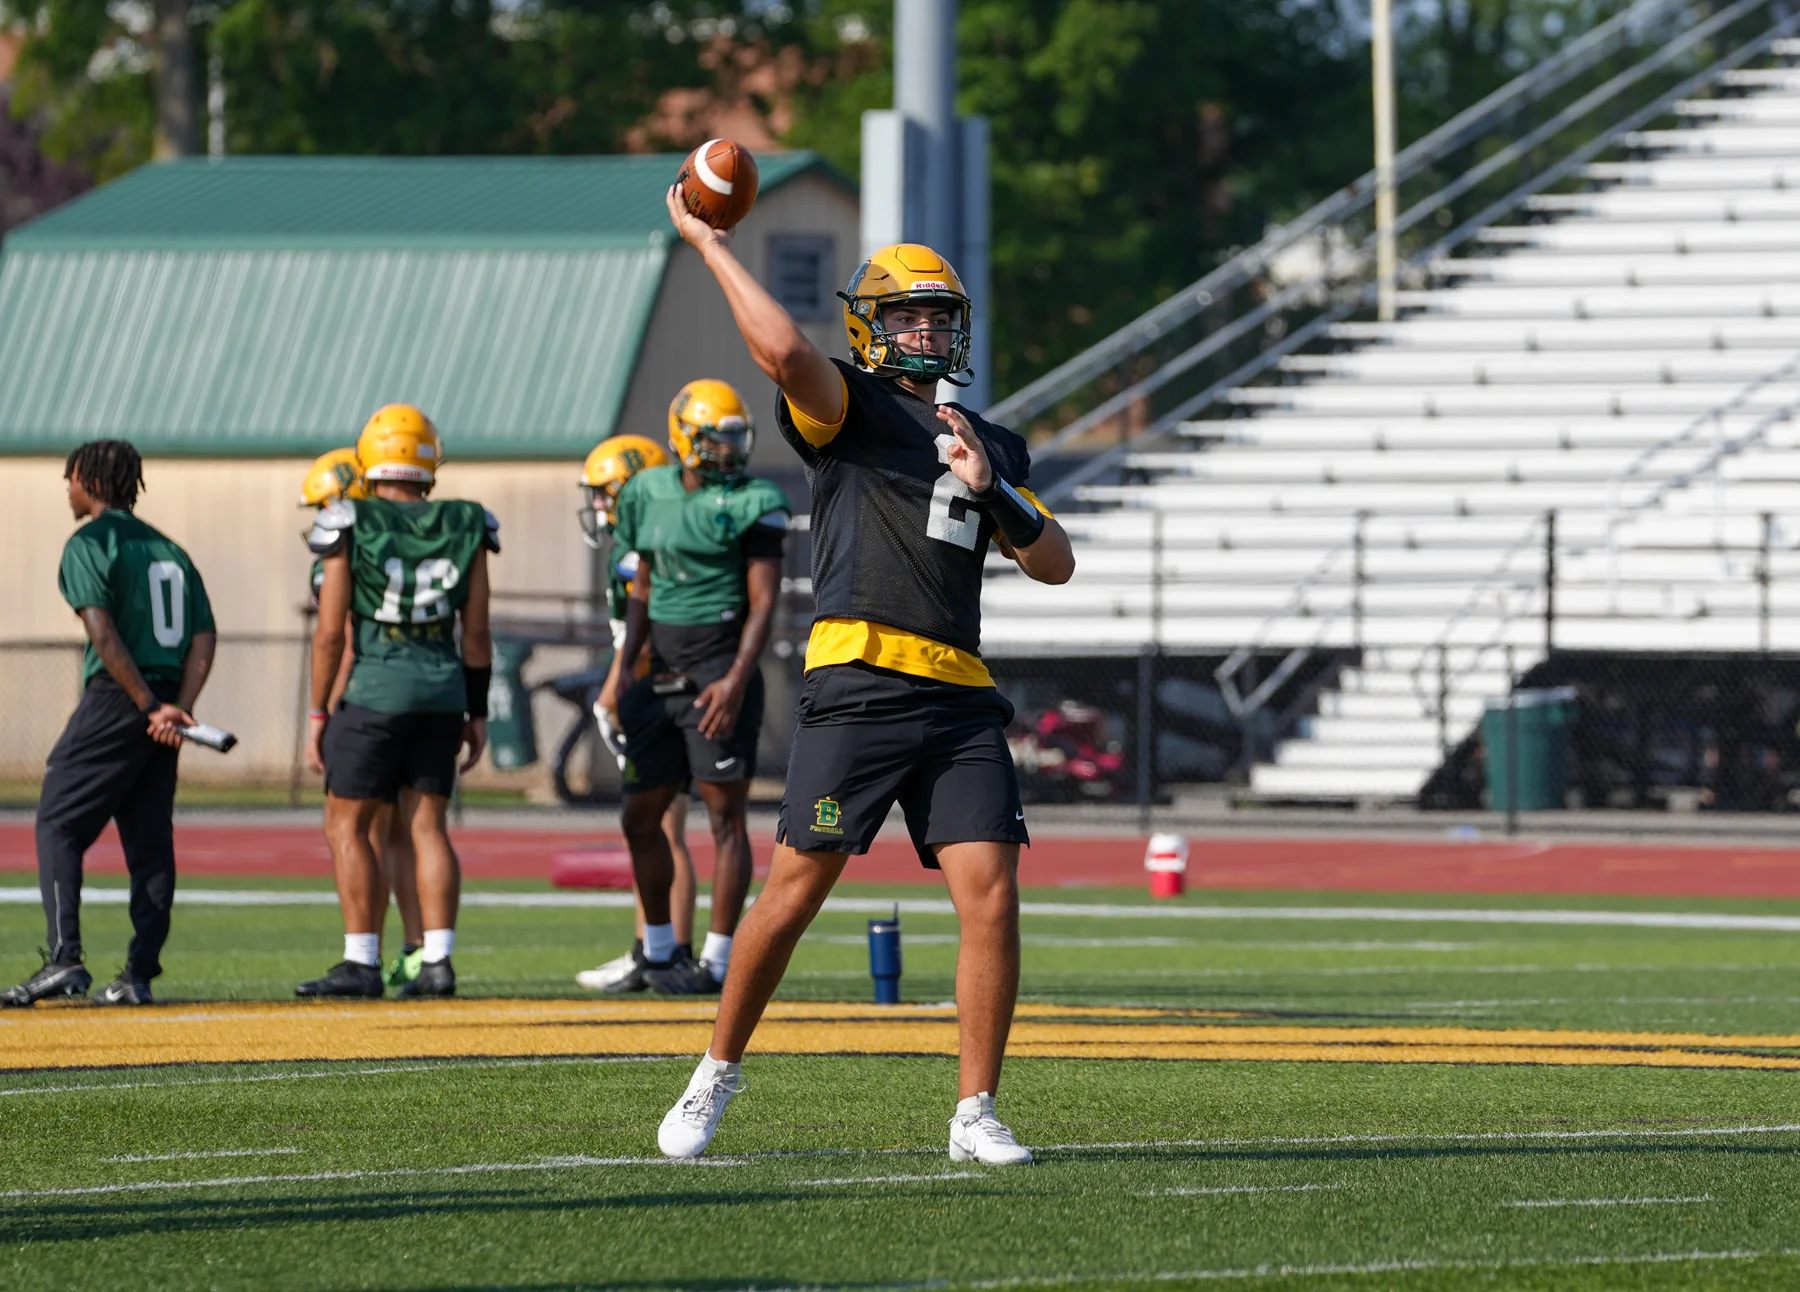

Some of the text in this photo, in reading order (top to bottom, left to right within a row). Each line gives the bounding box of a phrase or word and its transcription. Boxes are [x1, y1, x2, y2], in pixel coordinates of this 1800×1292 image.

[926, 433, 982, 551] 2
[148, 561, 184, 648] 0
[816, 799, 840, 827] B
